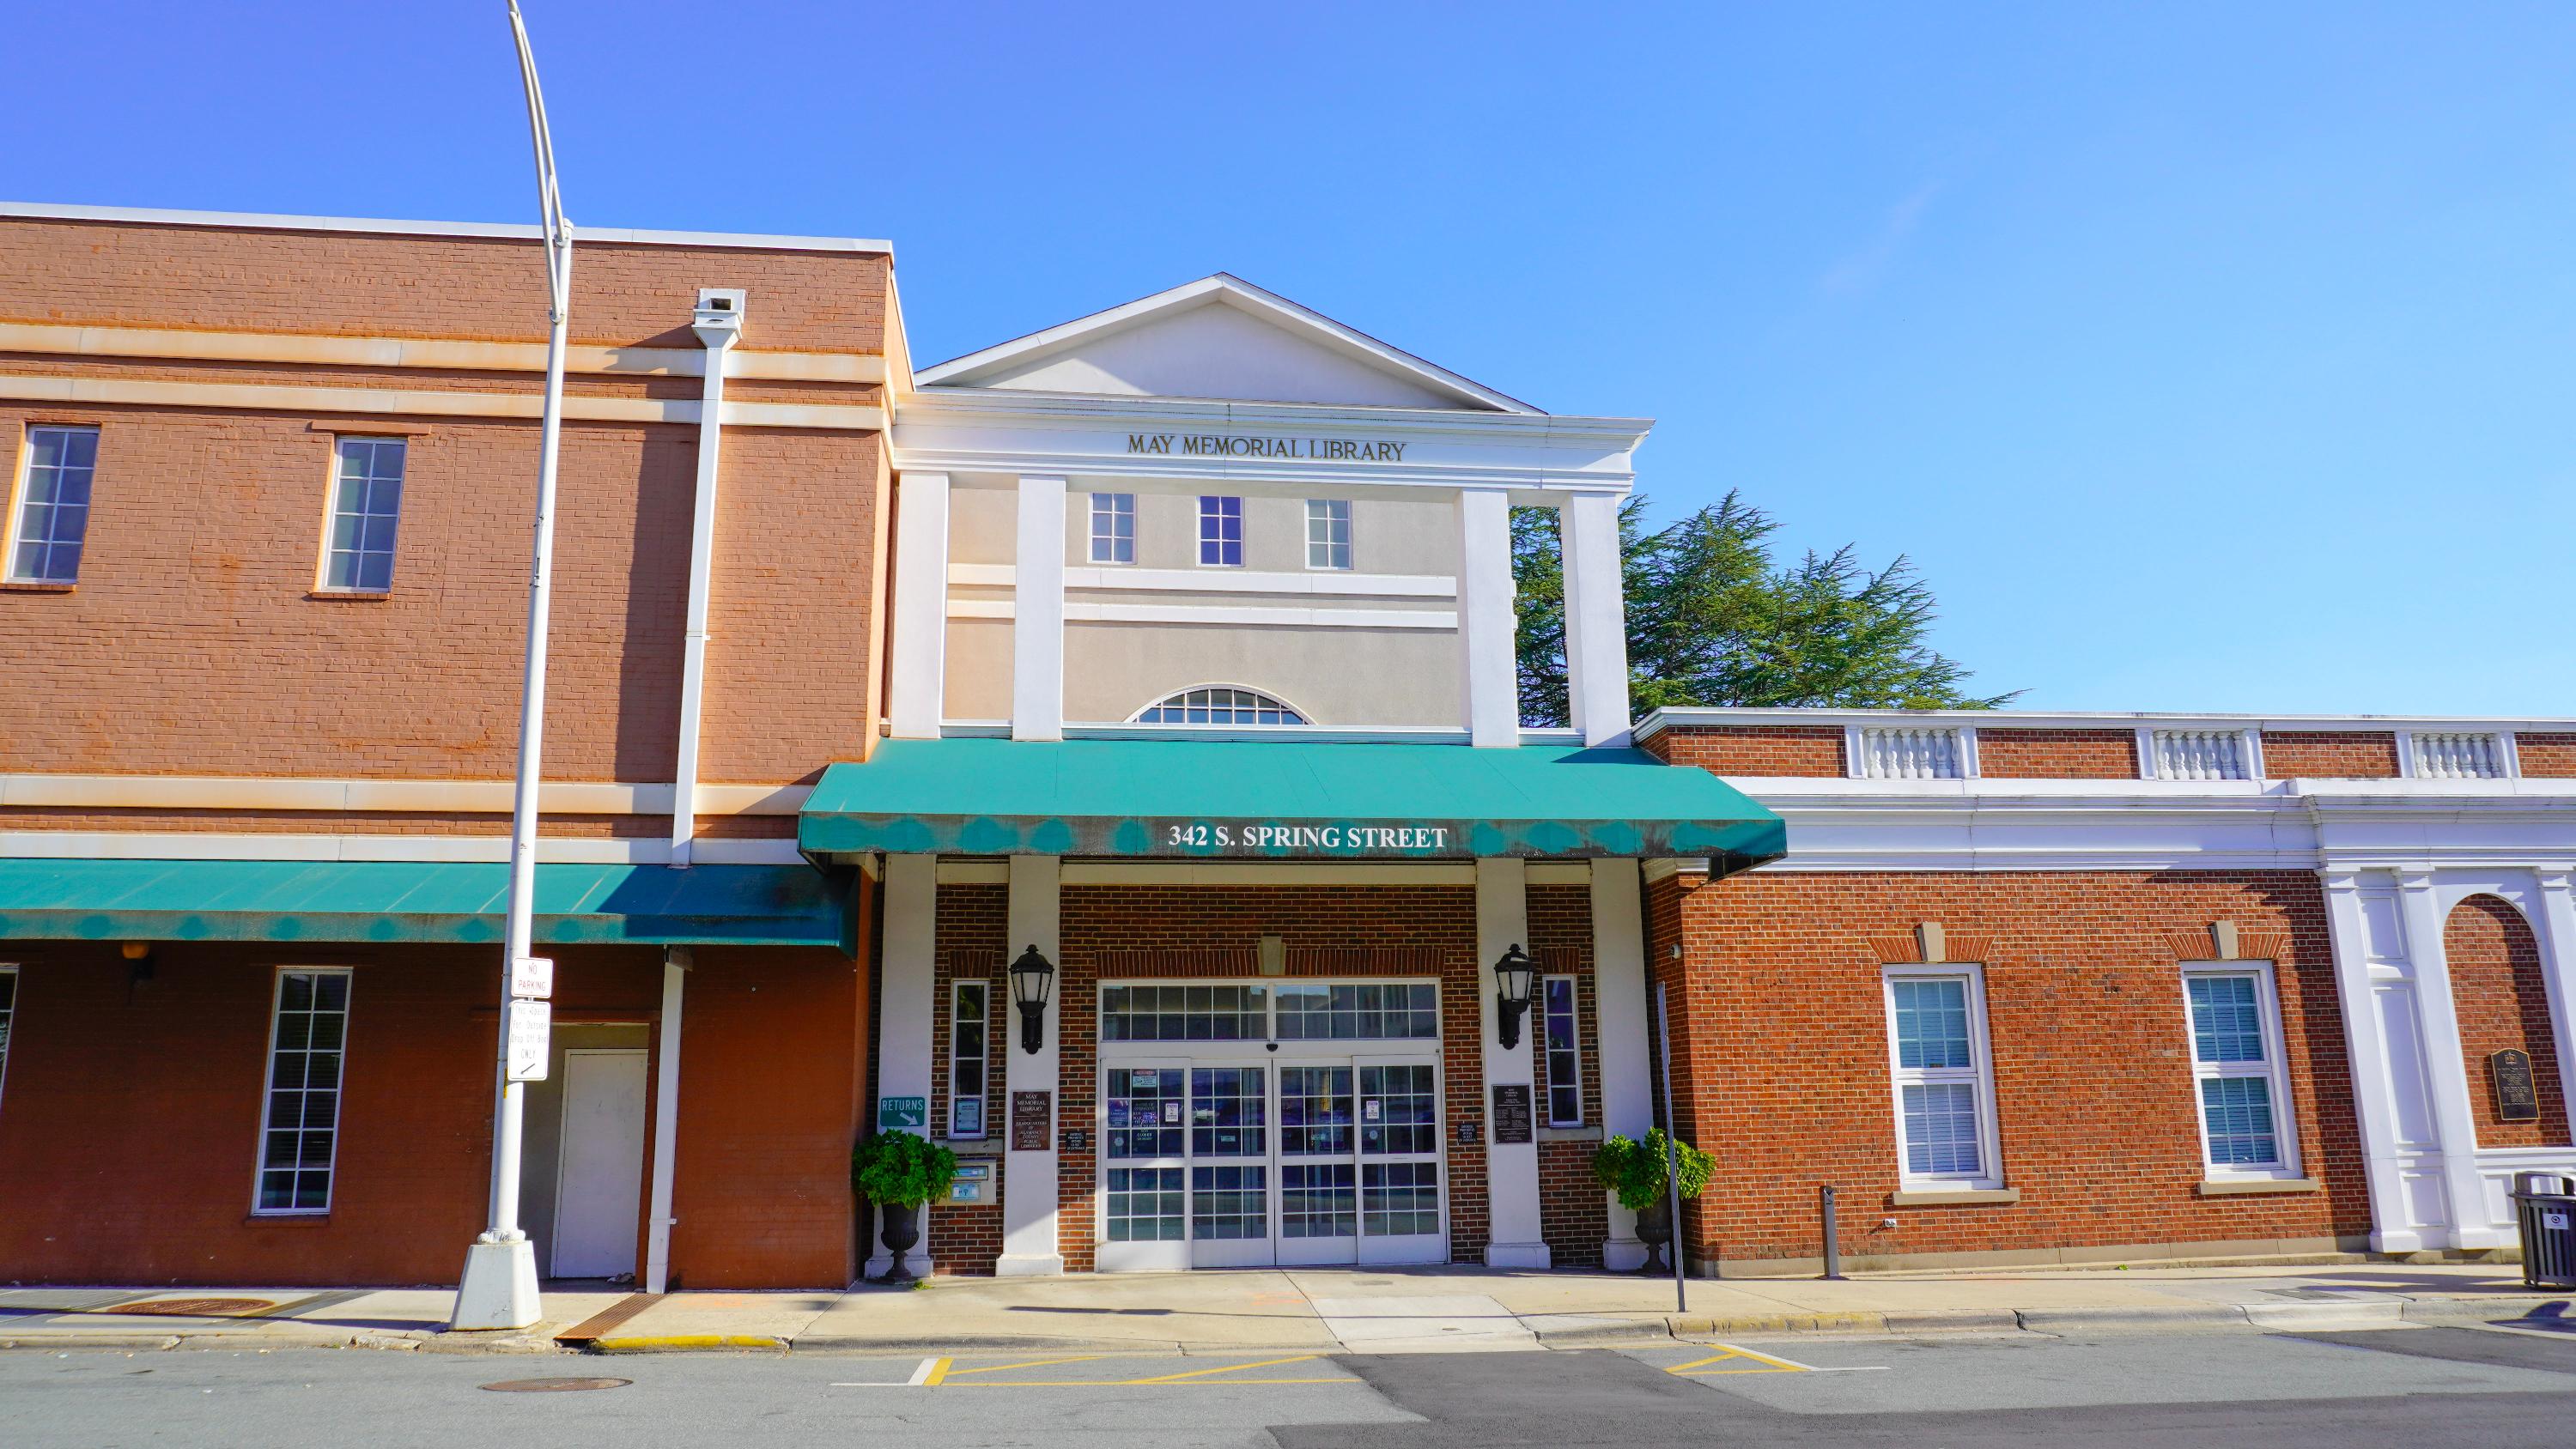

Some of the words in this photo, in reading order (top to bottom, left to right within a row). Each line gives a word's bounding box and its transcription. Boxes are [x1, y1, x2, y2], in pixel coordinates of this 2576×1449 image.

[1127, 433, 1175, 453] MAY
[1182, 436, 1303, 458] MEMORIAL
[1309, 440, 1406, 462] LIBRARY
[1169, 825, 1208, 846] 342
[1215, 825, 1236, 846] S.
[1243, 827, 1341, 847] SPRING
[1347, 828, 1448, 848] STREET
[528, 964, 538, 975] NO
[518, 979, 546, 991] PARKING
[520, 1048, 536, 1059] ONLY
[882, 1099, 924, 1112] RETURNS
